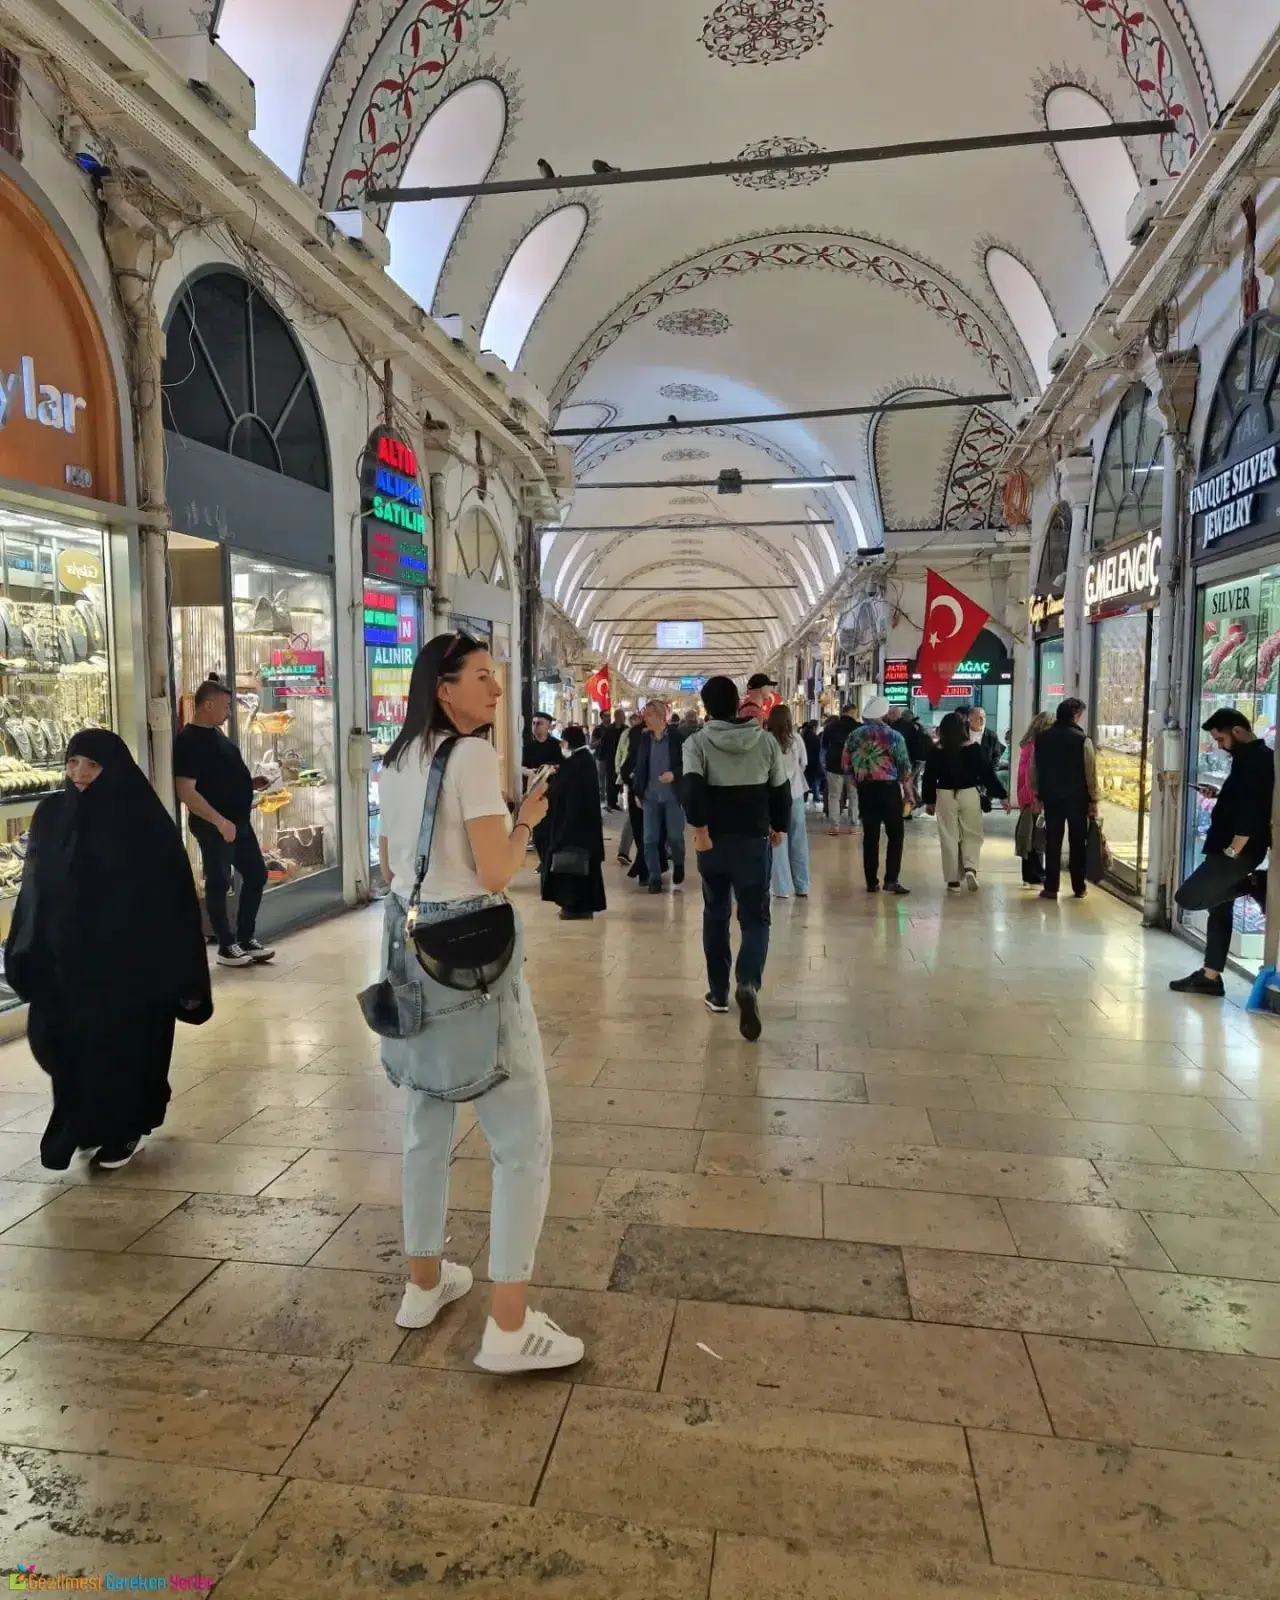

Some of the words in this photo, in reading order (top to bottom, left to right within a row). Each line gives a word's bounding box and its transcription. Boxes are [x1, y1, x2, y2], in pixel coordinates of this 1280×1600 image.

[378, 436, 417, 478] ALTIN
[1190, 470, 1232, 516] UNIQUE
[1232, 446, 1277, 496] SILVER
[1203, 493, 1254, 549] JEWELRY
[1212, 586, 1250, 614] SILVER
[374, 648, 412, 665] ALINIR
